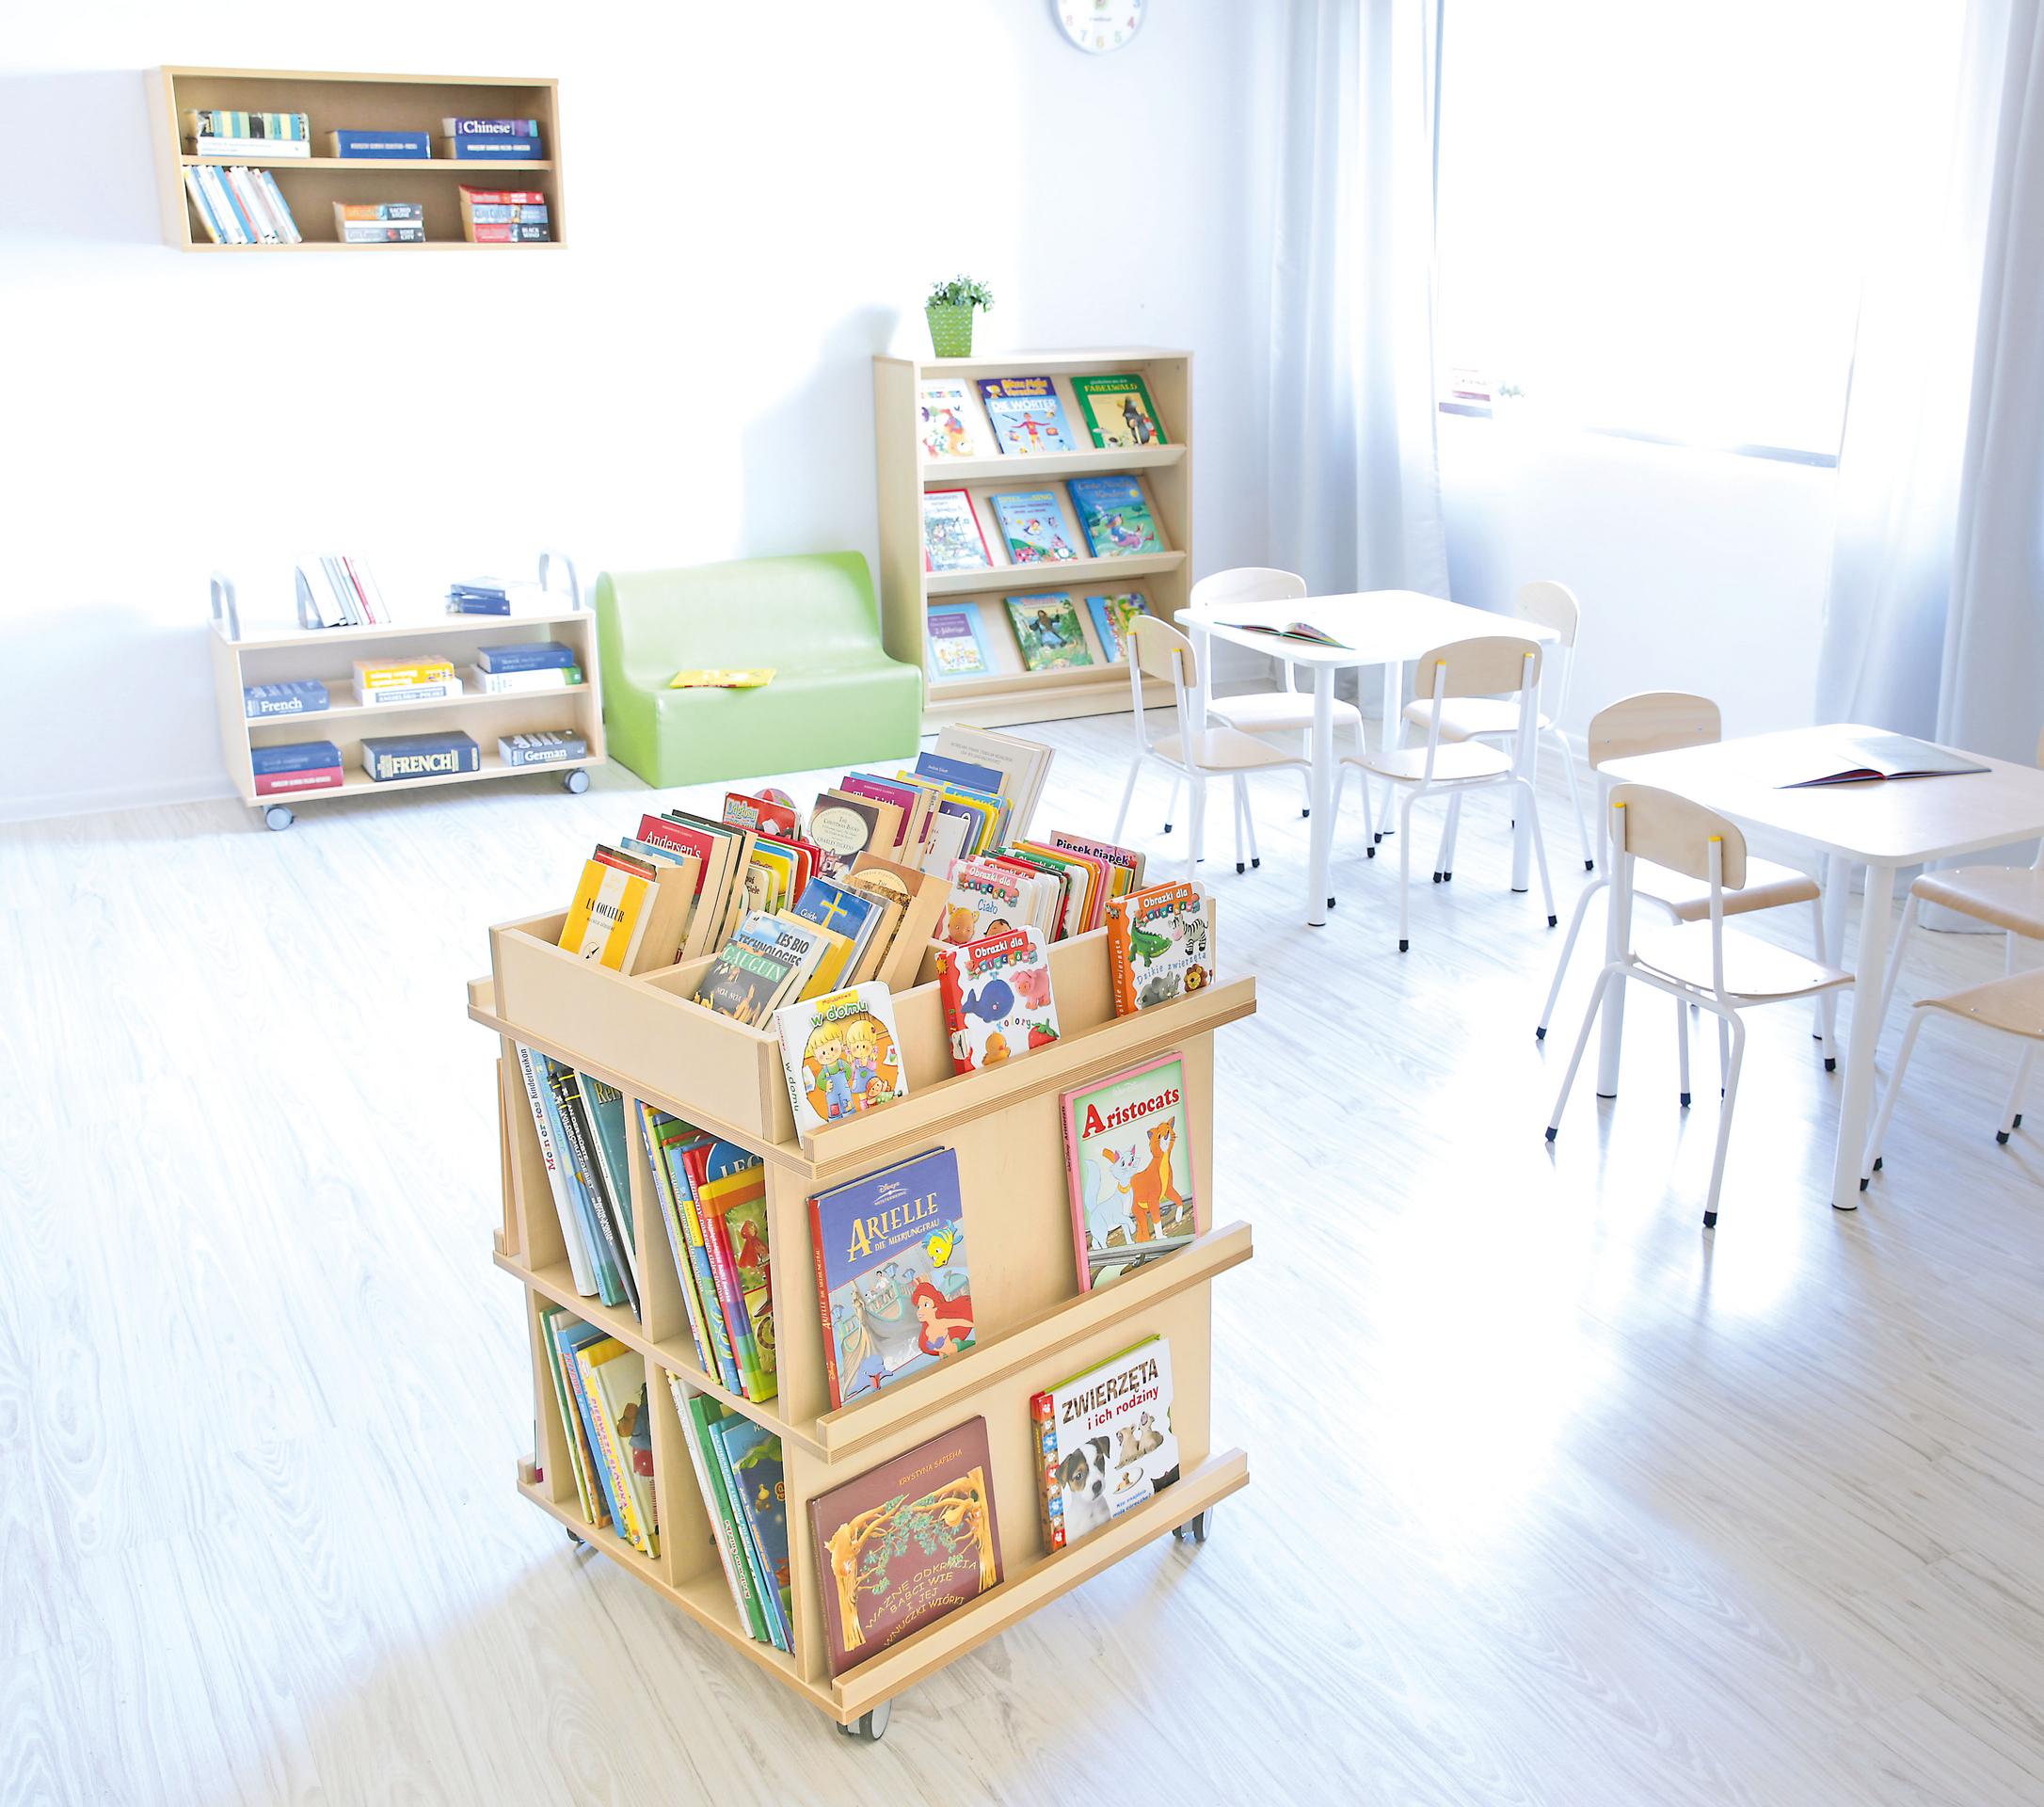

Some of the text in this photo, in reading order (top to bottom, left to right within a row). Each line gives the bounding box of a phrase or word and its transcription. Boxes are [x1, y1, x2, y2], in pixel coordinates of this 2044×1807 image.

[463, 120, 511, 134] Chinese
[991, 398, 1057, 412] DIE WÖRTER
[260, 697, 304, 712] French
[391, 753, 453, 773] FRENCH
[524, 747, 567, 761] German
[645, 830, 701, 858] Andersen's
[1056, 838, 1092, 856] Piesek
[969, 867, 1012, 887] Obrazki dla
[964, 880, 1012, 903] maluchów
[1143, 888, 1189, 908] Obrazki dla
[800, 908, 818, 921] Guide
[977, 899, 998, 915] Ciało
[1142, 902, 1192, 923] maluchów
[775, 932, 810, 954] LES BIO
[974, 936, 1024, 958] Obrazki dla
[722, 944, 787, 983] GAUGUIN
[974, 951, 1029, 975] maluchów
[1137, 951, 1206, 985] Dzikie zwierzęta
[716, 986, 742, 1002] NOA NOA
[811, 1000, 868, 1027] w domu
[520, 1047, 539, 1099] Kinderlexikon
[785, 1062, 792, 1073] w
[789, 1076, 800, 1111] domu
[1081, 1088, 1180, 1140] Aristocats
[567, 1104, 589, 1160] AN DER KÜSTE
[847, 1191, 939, 1263] ARIELLE
[874, 1218, 940, 1252] DIE MEERJUNGFRAU
[819, 1301, 831, 1330] ARIELLE
[1062, 1357, 1159, 1425] ZWIERZĘTA
[1088, 1384, 1159, 1431] i ich rodziny
[899, 1447, 964, 1487] KRYSTYNA SAPIEHA
[722, 1518, 751, 1599] Królewna Śnieżka
[889, 1572, 954, 1613] BABCI WIE
[918, 1587, 939, 1604] JEJ
[884, 1604, 927, 1646] WNUCZKI
